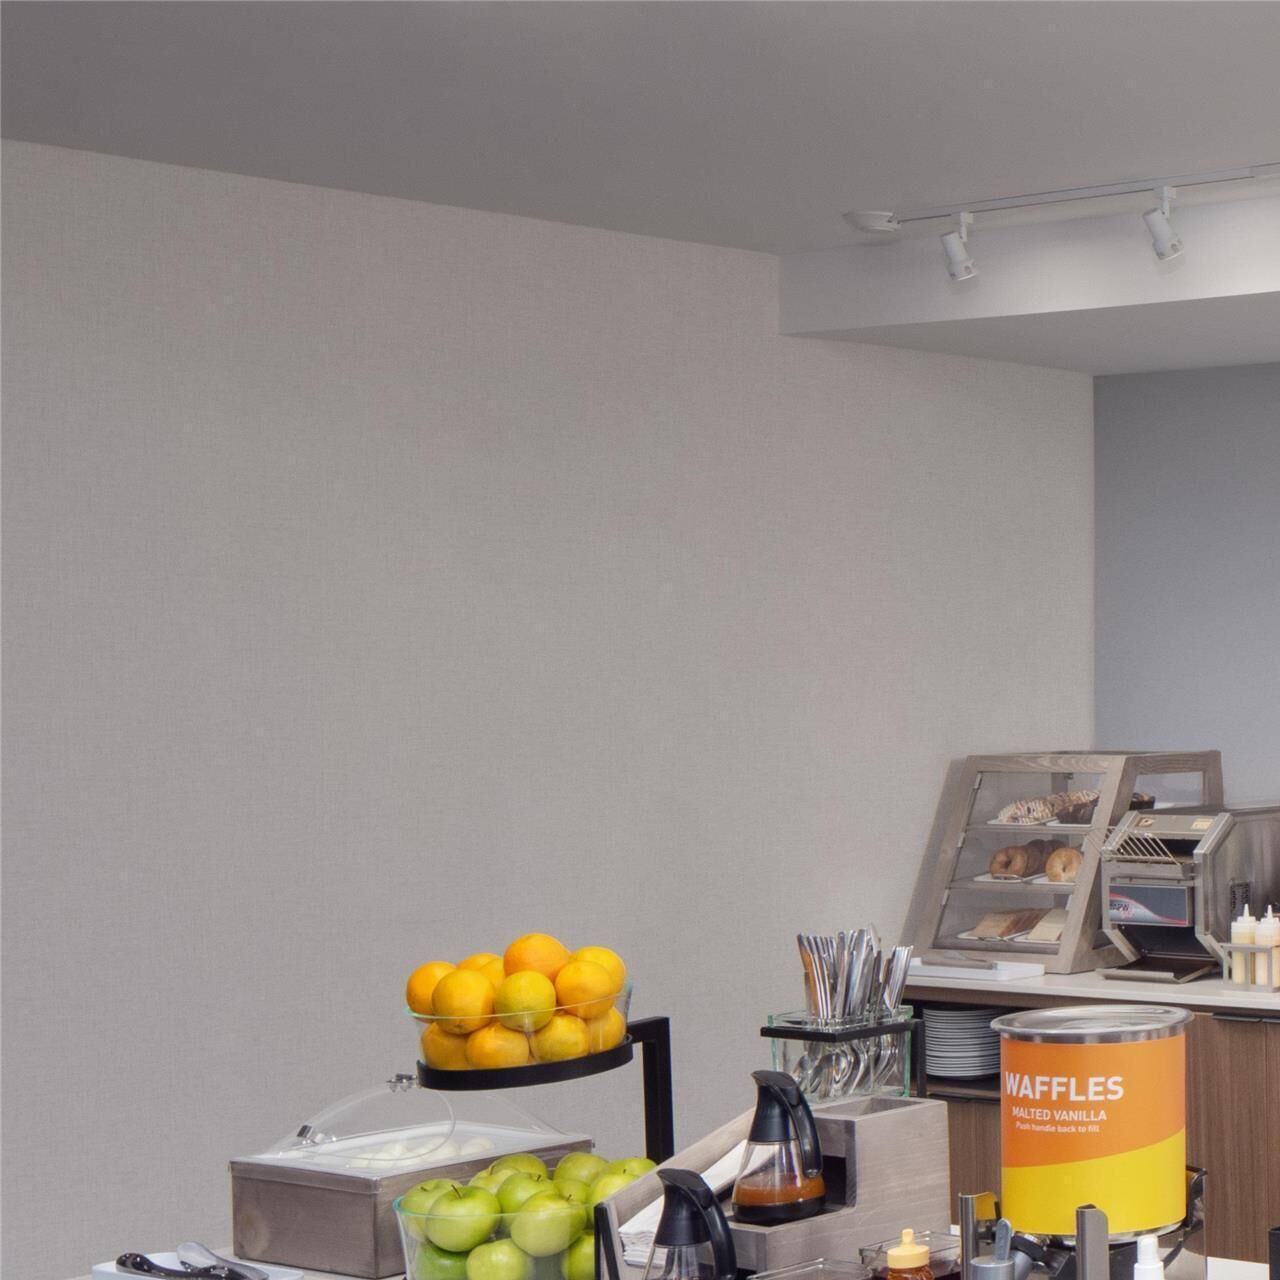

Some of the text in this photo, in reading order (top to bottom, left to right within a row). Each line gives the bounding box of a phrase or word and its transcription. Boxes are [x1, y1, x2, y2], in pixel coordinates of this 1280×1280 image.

[1006, 1072, 1124, 1102] WAFFLES
[1012, 1106, 1051, 1121] MALTED
[1053, 1110, 1107, 1121] VANILLA
